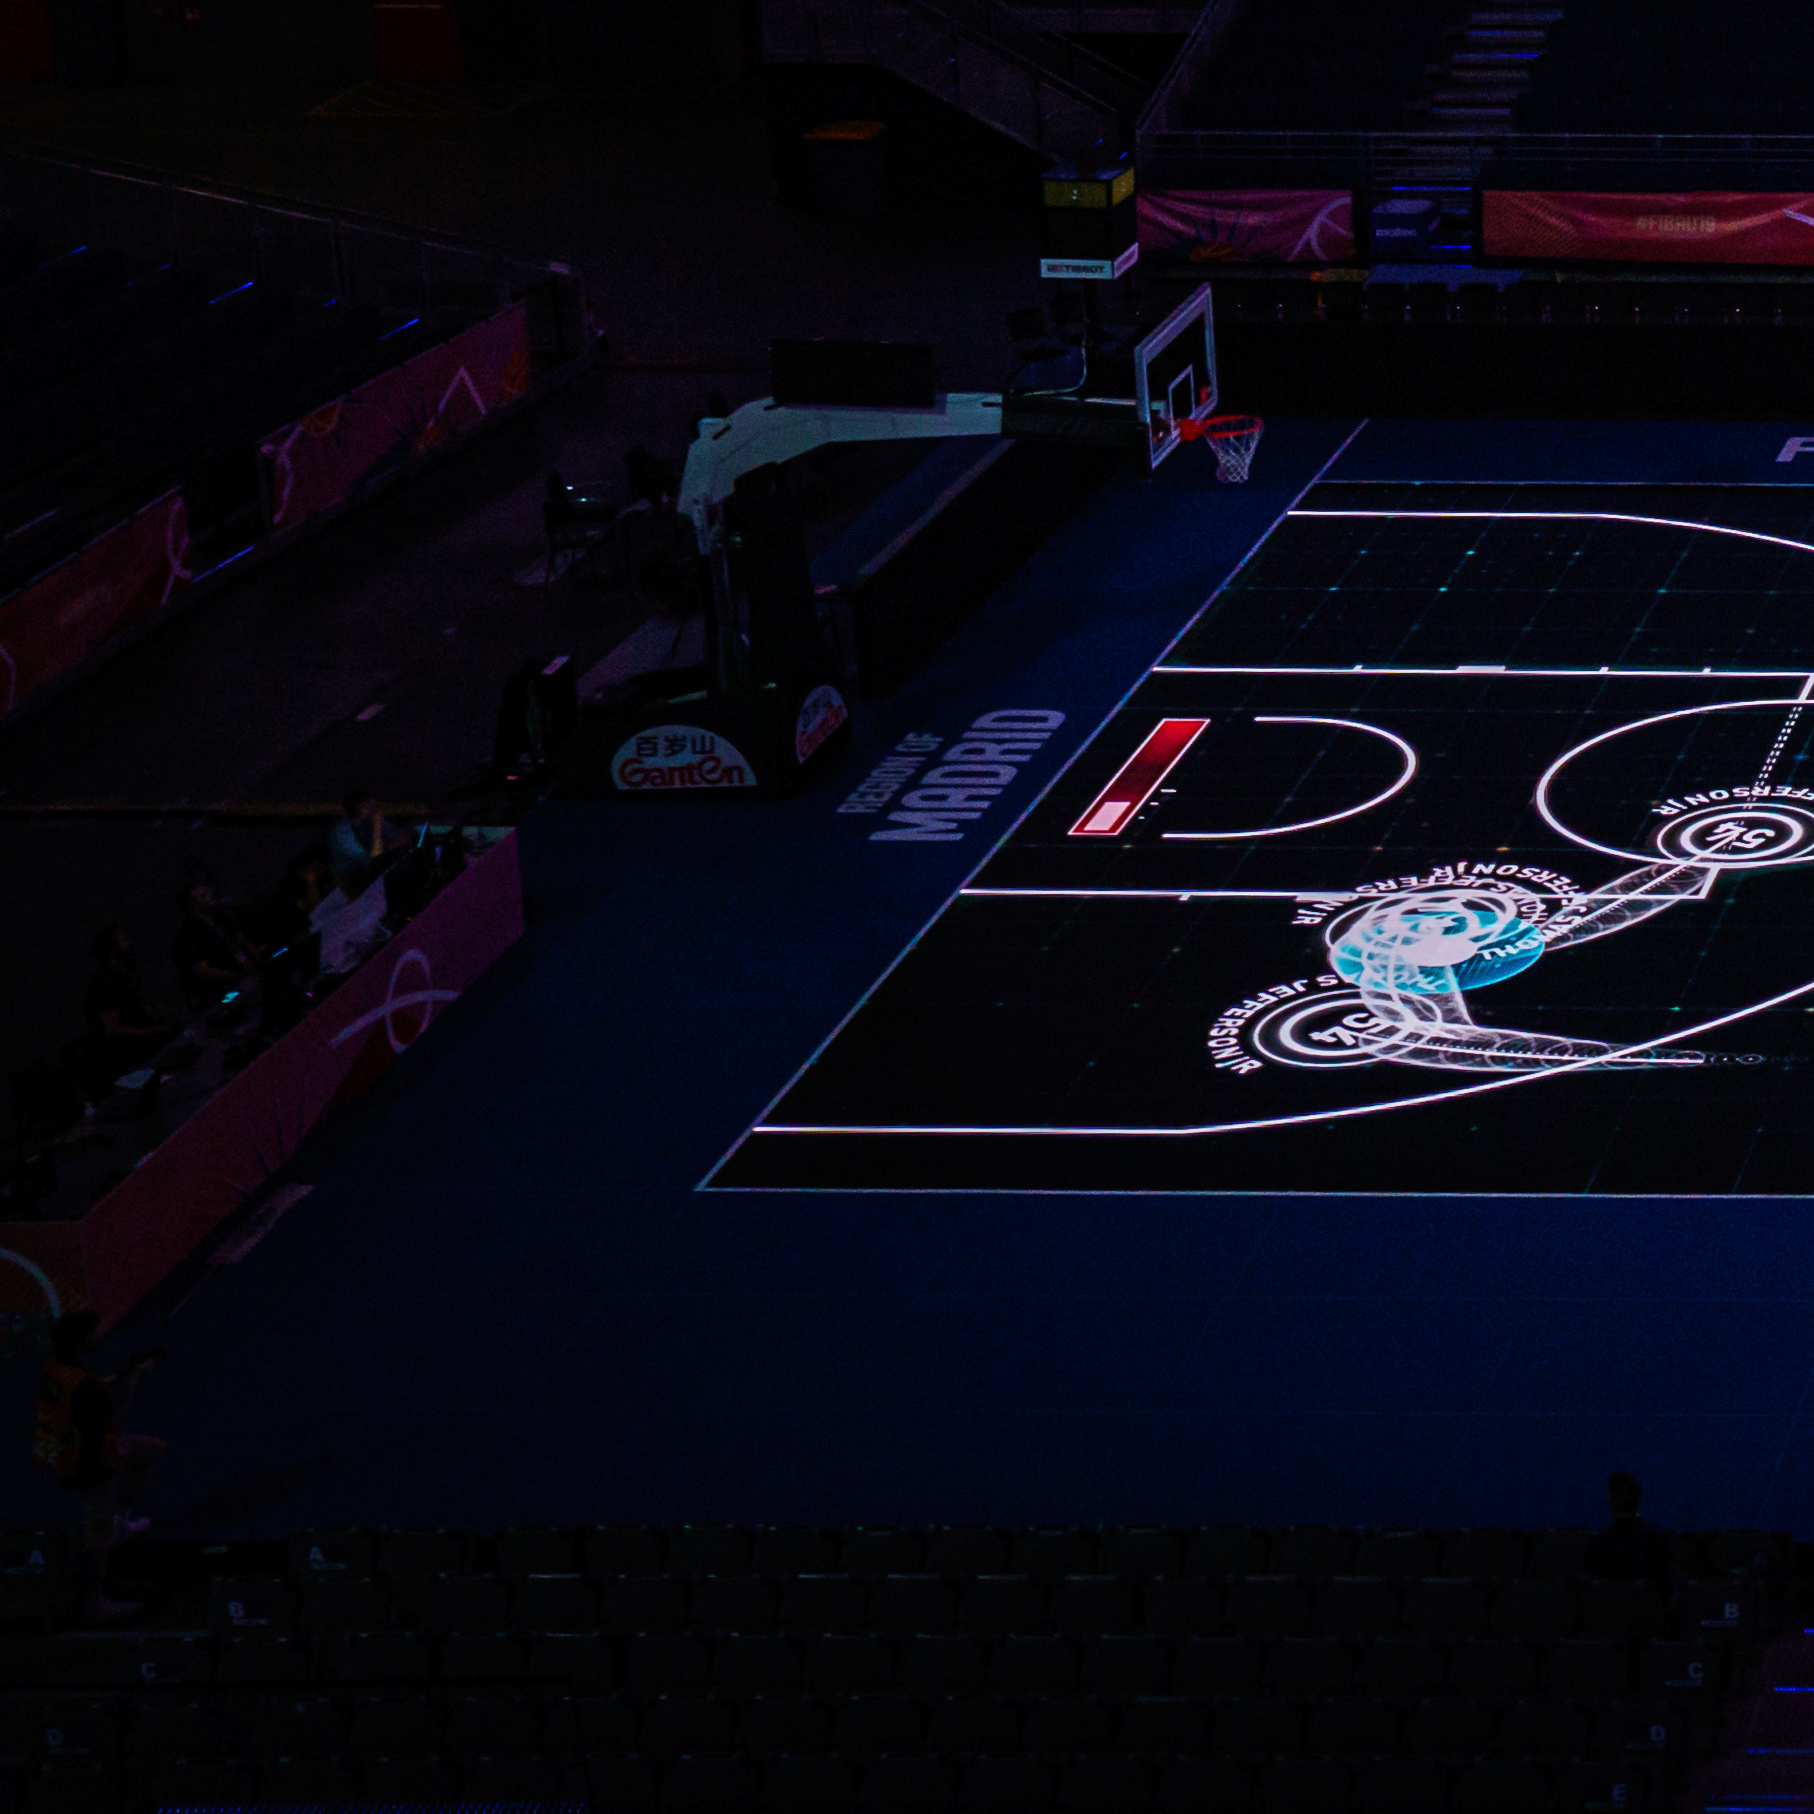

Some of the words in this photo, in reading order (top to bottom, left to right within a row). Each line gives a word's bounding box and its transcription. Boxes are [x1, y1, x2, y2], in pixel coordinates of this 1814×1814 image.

[636, 735, 715, 757] 百岁山
[868, 709, 1066, 842] MADRID
[1207, 978, 1309, 1058] JEFFERSON
[1308, 1013, 1393, 1047] 54
